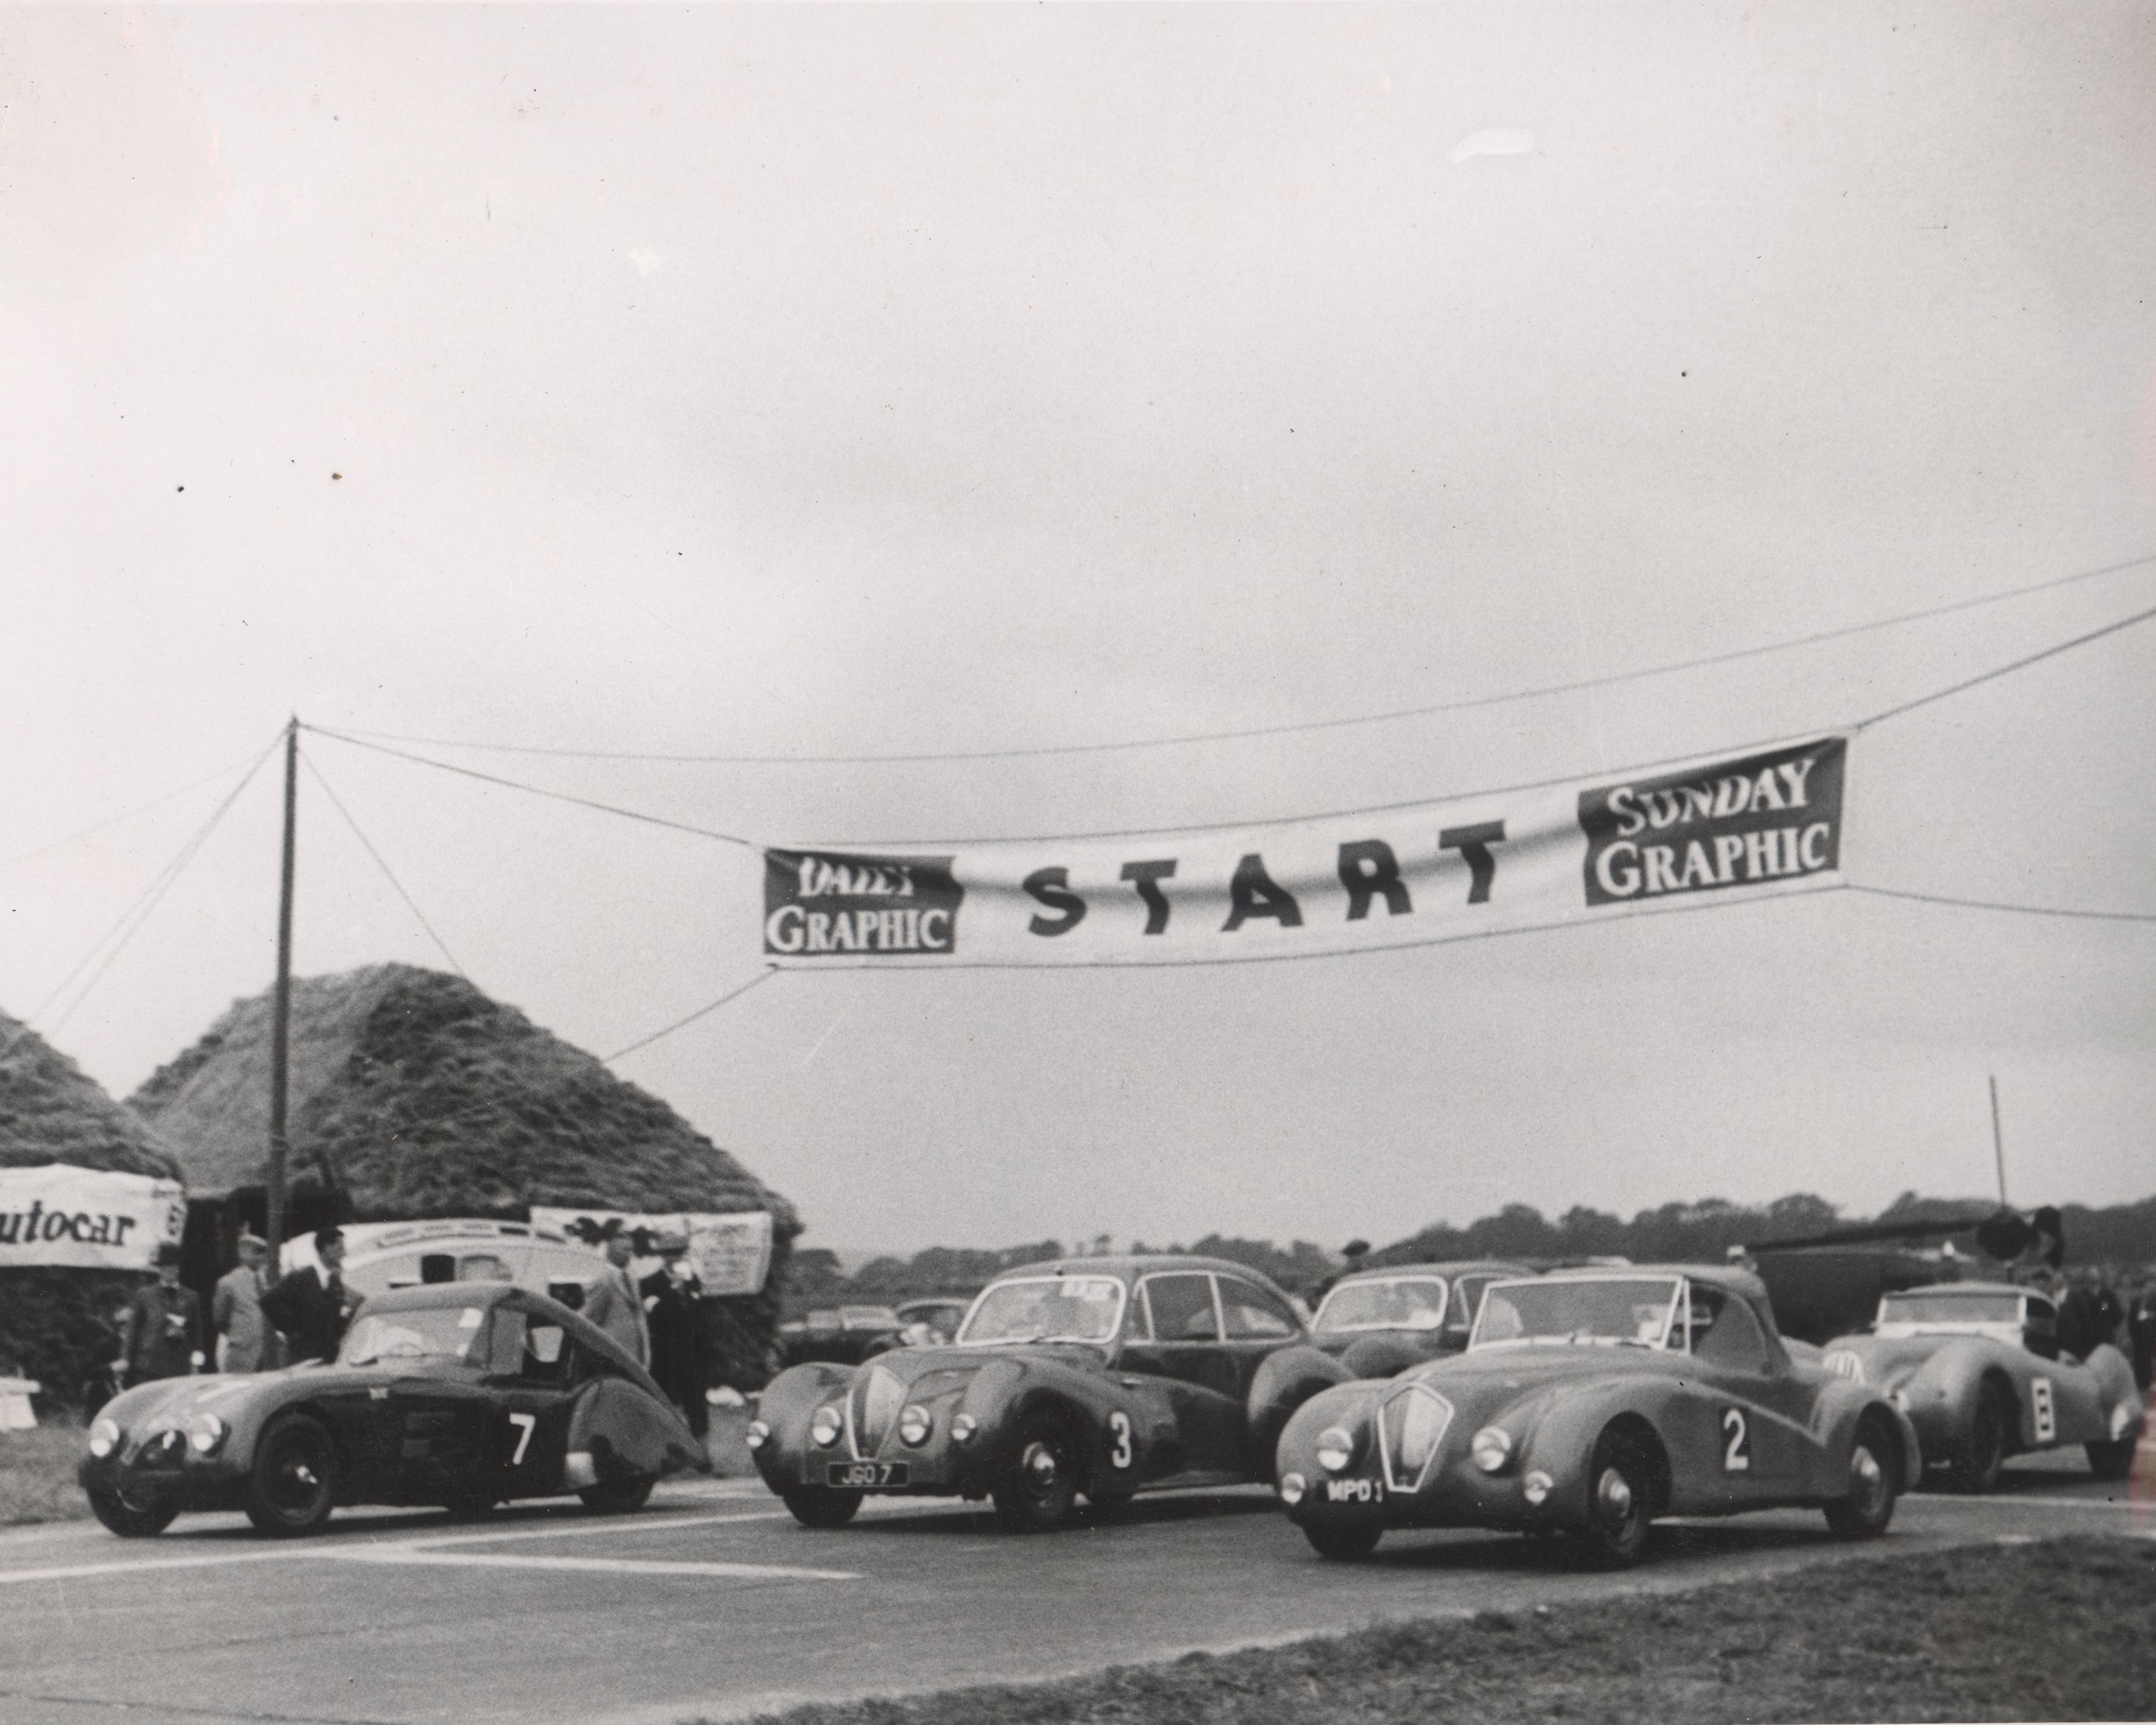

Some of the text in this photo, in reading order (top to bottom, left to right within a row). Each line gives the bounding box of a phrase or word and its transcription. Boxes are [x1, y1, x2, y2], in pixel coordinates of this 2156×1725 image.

[1607, 759, 1814, 837] SUNDAY
[1023, 820, 1507, 937] START
[1596, 823, 1829, 897] GRAPHIC
[767, 906, 949, 951] GRAPHIC
[509, 1412, 536, 1465] 7
[1111, 1412, 1131, 1468] 3
[1723, 1408, 1749, 1470] 2
